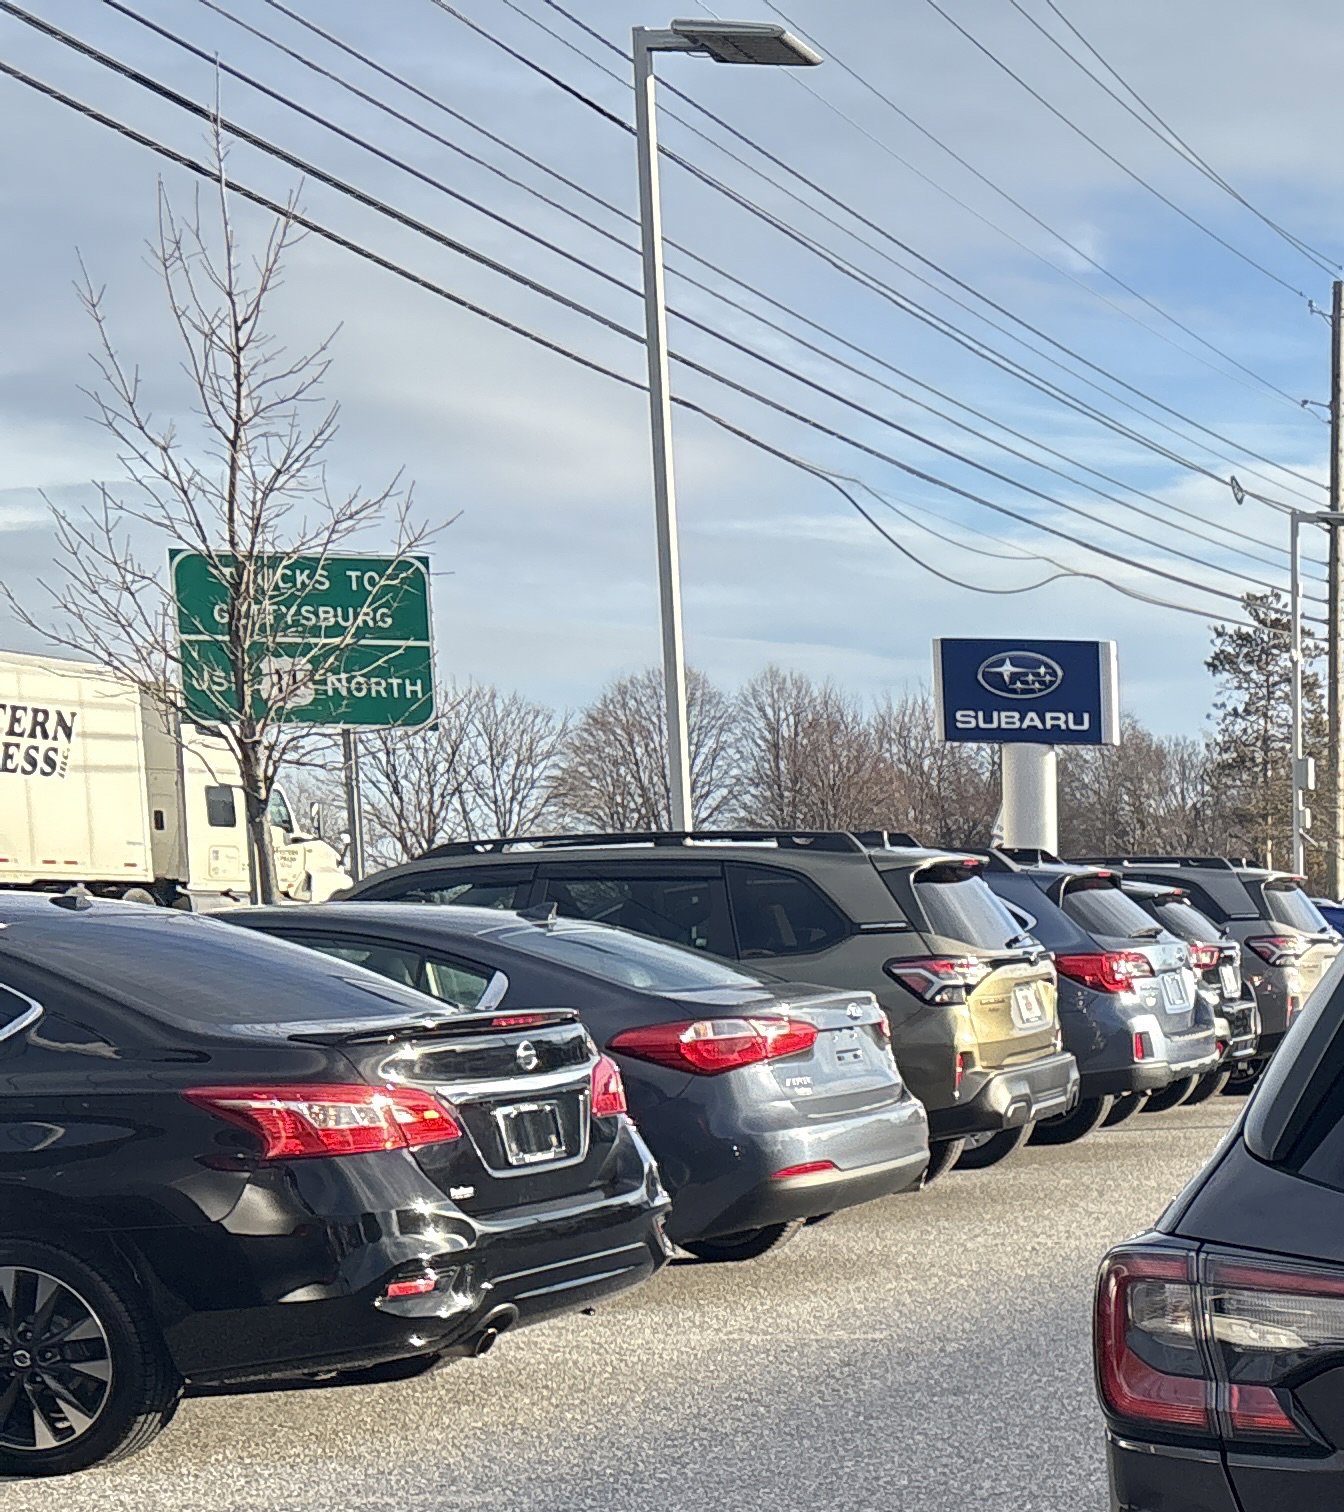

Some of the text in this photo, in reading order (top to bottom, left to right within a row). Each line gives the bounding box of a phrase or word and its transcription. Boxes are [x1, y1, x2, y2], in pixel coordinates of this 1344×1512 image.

[222, 567, 380, 591] TUCKS TO
[213, 604, 393, 628] GTTYSBURG
[326, 673, 423, 699] NORTH
[955, 710, 1090, 731] SUBARU
